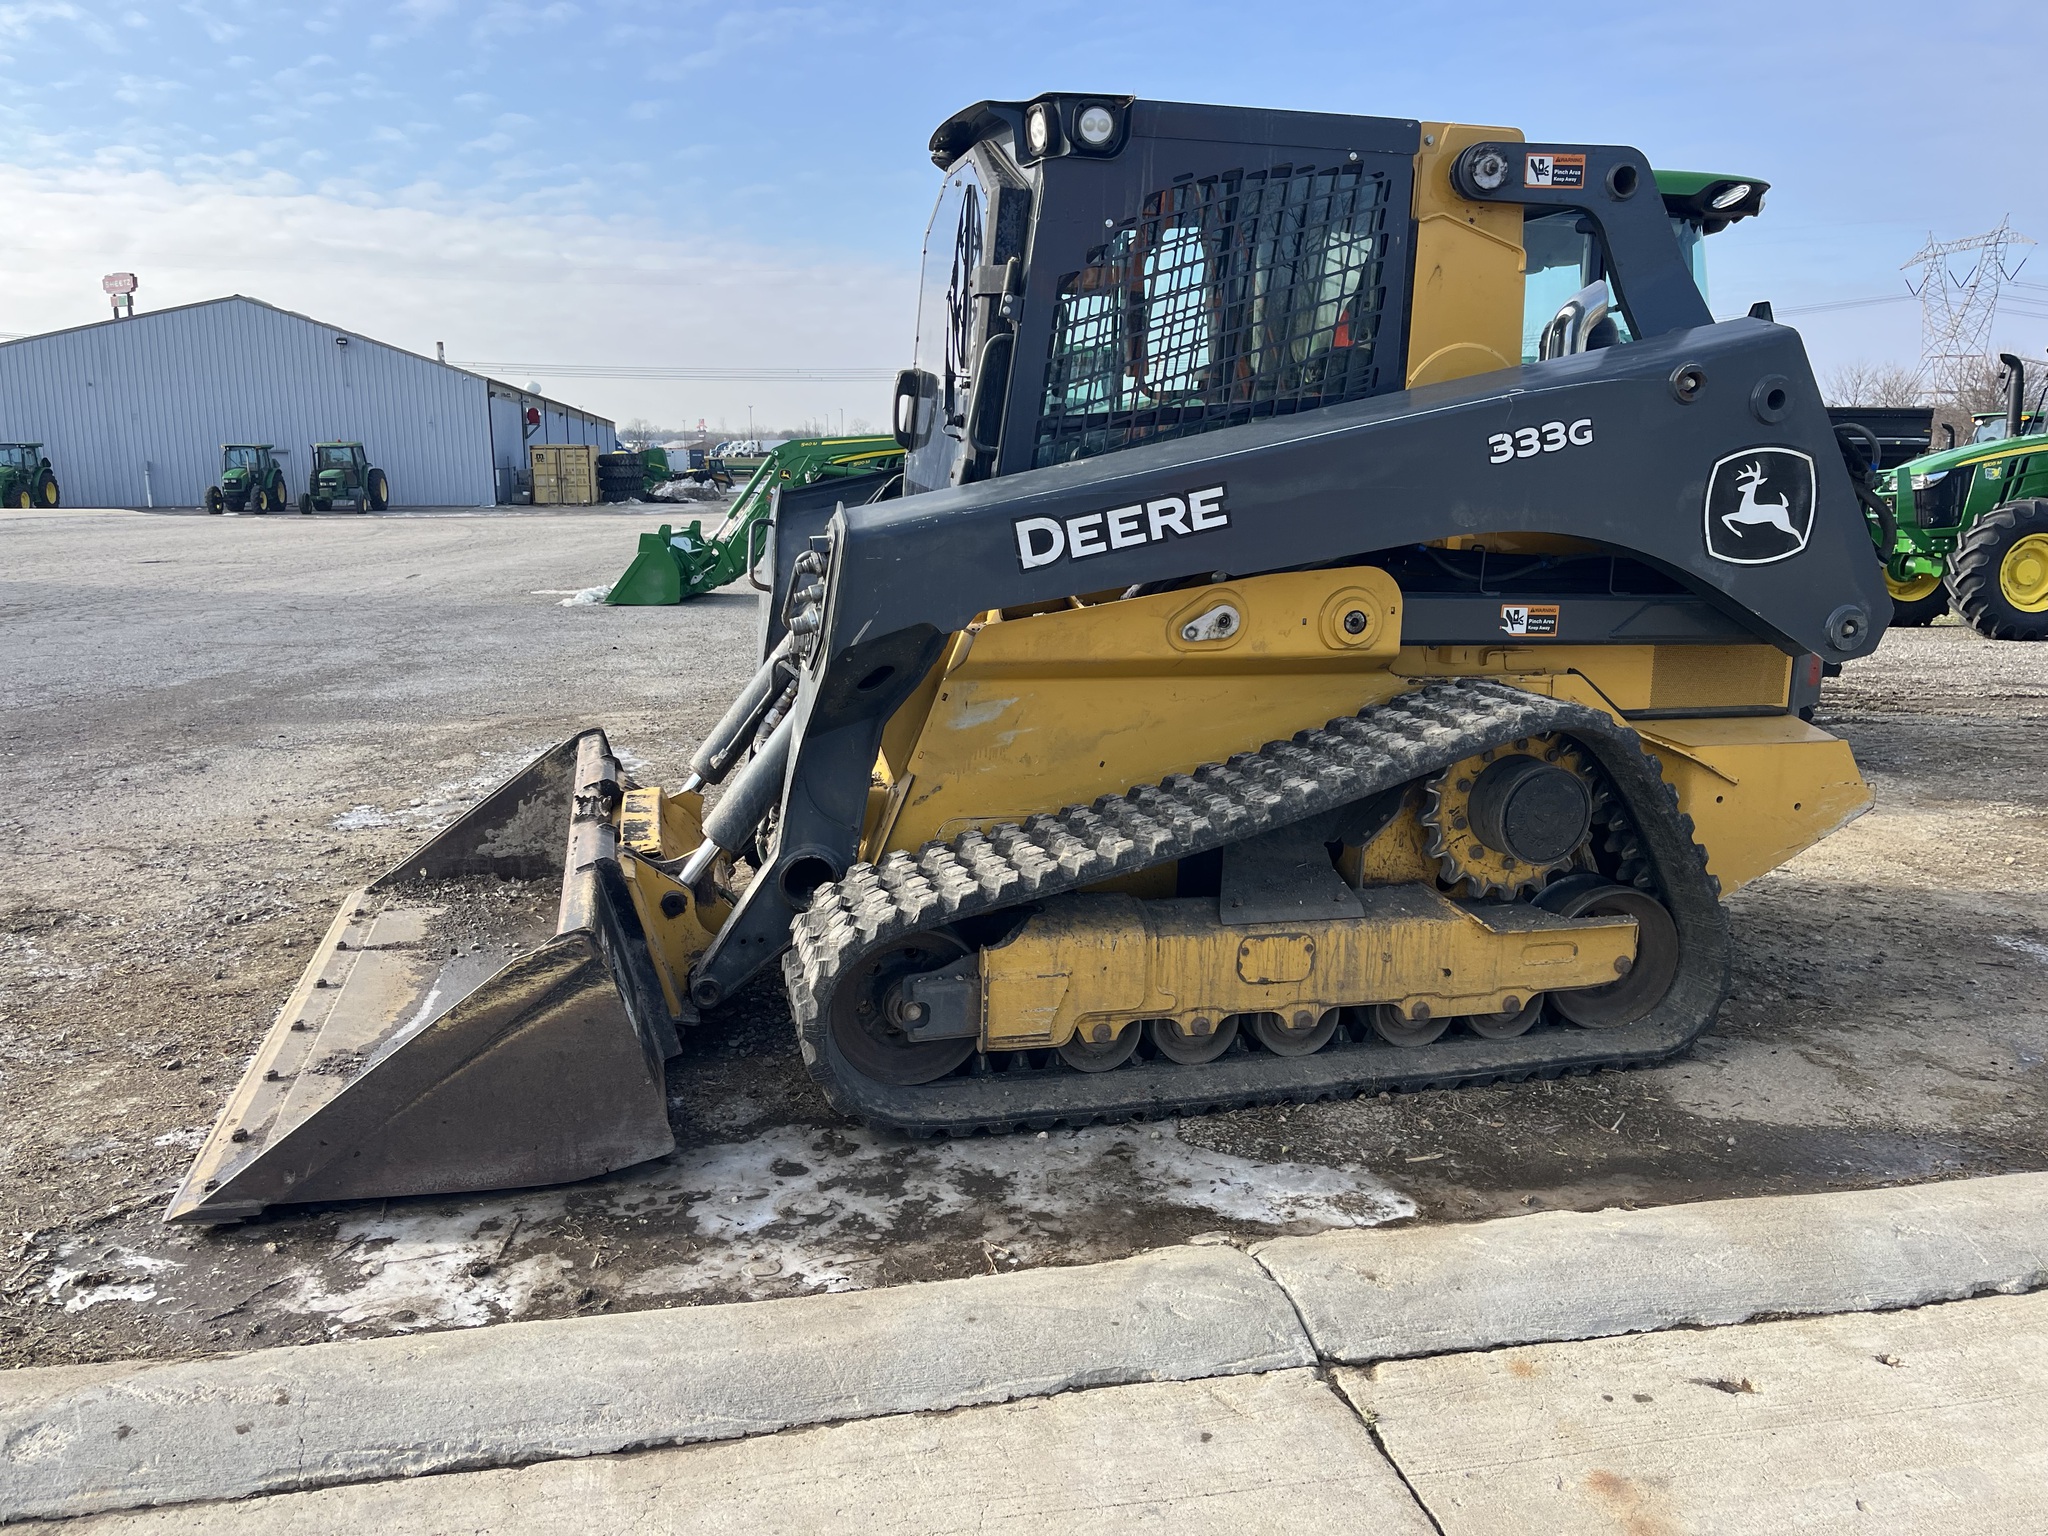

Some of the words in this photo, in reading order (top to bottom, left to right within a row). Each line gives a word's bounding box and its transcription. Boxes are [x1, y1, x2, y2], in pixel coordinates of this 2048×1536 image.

[105, 279, 131, 288] SHEETZ
[1488, 418, 1593, 464] 333G
[1015, 486, 1228, 570] DEERE
